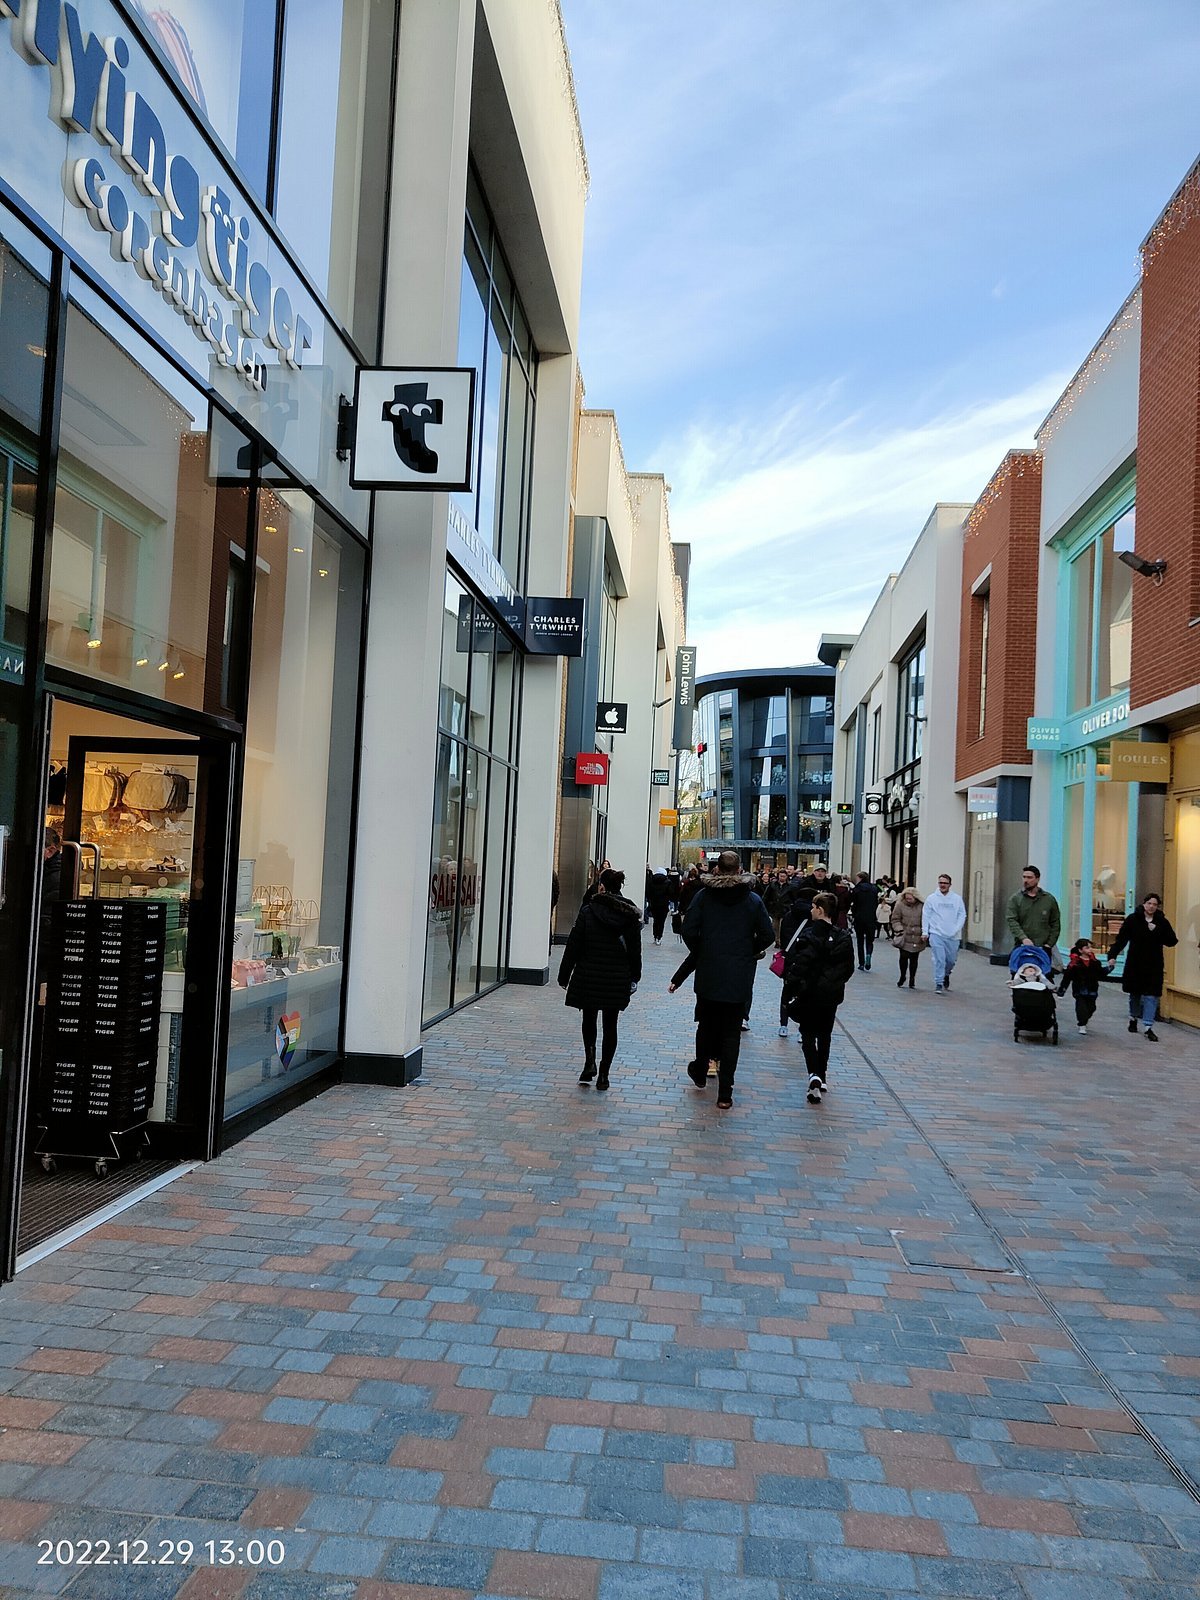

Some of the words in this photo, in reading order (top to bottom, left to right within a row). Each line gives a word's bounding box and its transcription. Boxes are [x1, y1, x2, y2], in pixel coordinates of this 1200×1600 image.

[0, 0, 200, 248] lying
[204, 185, 313, 371] tiger
[448, 503, 480, 558] HARLES
[529, 623, 580, 632] TYRWHITT
[533, 615, 576, 624] CHARLES
[680, 649, 694, 675] John
[680, 676, 693, 705] Lewis
[1082, 710, 1111, 735] OLIVER
[431, 873, 457, 909] SALE
